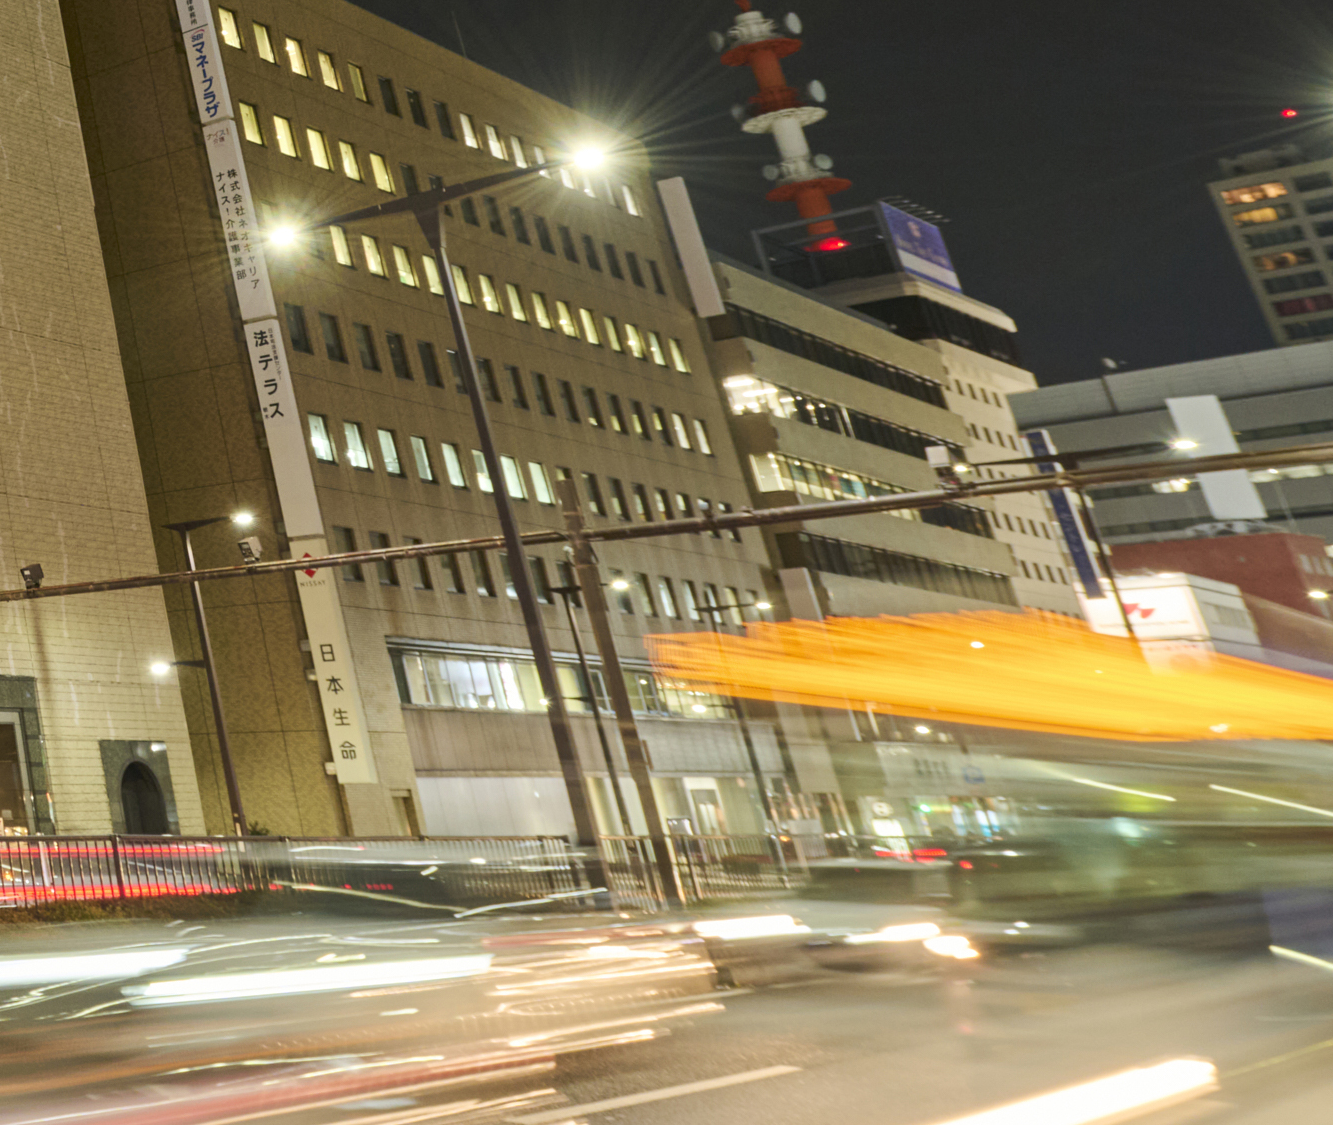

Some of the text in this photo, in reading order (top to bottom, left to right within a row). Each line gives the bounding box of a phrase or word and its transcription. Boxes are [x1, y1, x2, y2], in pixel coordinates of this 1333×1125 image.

[192, 41, 221, 118] マネープラザ
[226, 168, 261, 290] 株式会社ネオキャリア
[253, 329, 285, 419] 法テラス
[299, 580, 327, 588] NISSAY
[319, 642, 358, 762] 日本生命
